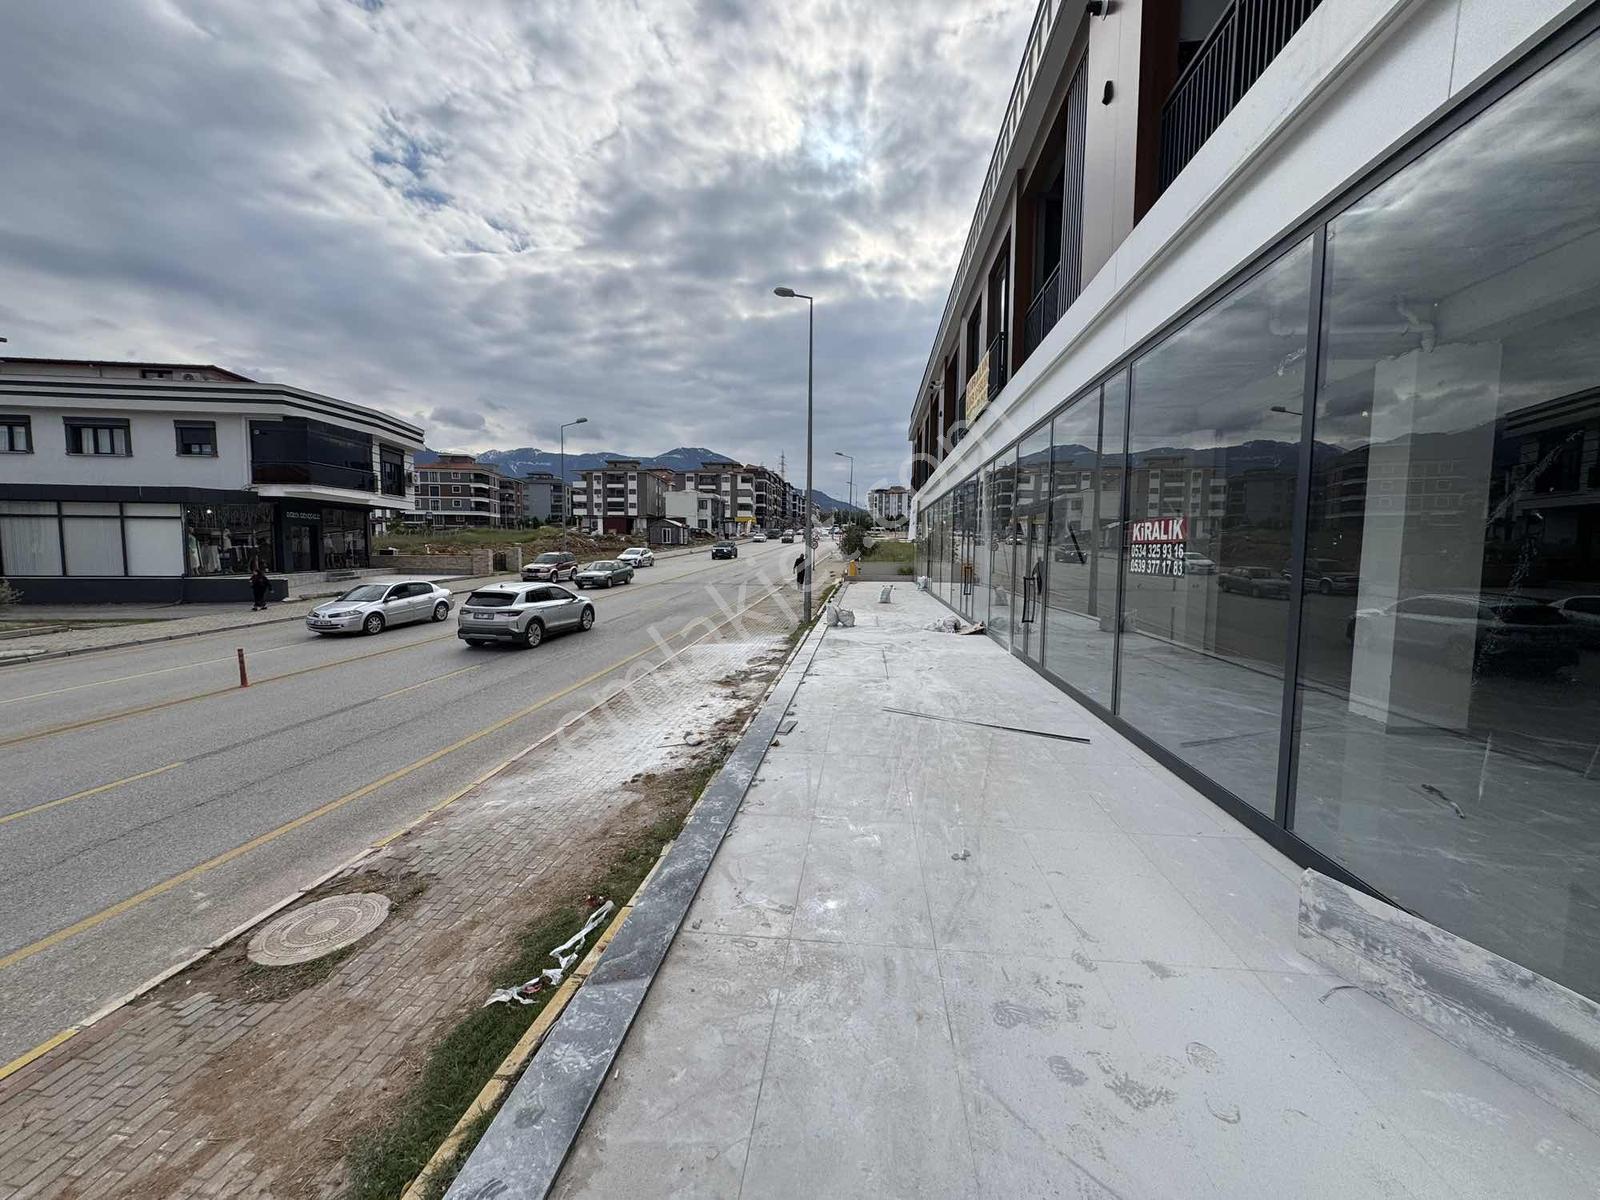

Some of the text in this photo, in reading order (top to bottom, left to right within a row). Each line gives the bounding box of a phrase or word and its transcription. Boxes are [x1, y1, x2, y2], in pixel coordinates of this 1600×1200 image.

[1131, 544, 1184, 558] 0534 325 93 16
[1130, 560, 1146, 572] 0539
[1147, 560, 1160, 573] 377
[1162, 561, 1171, 574] 17
